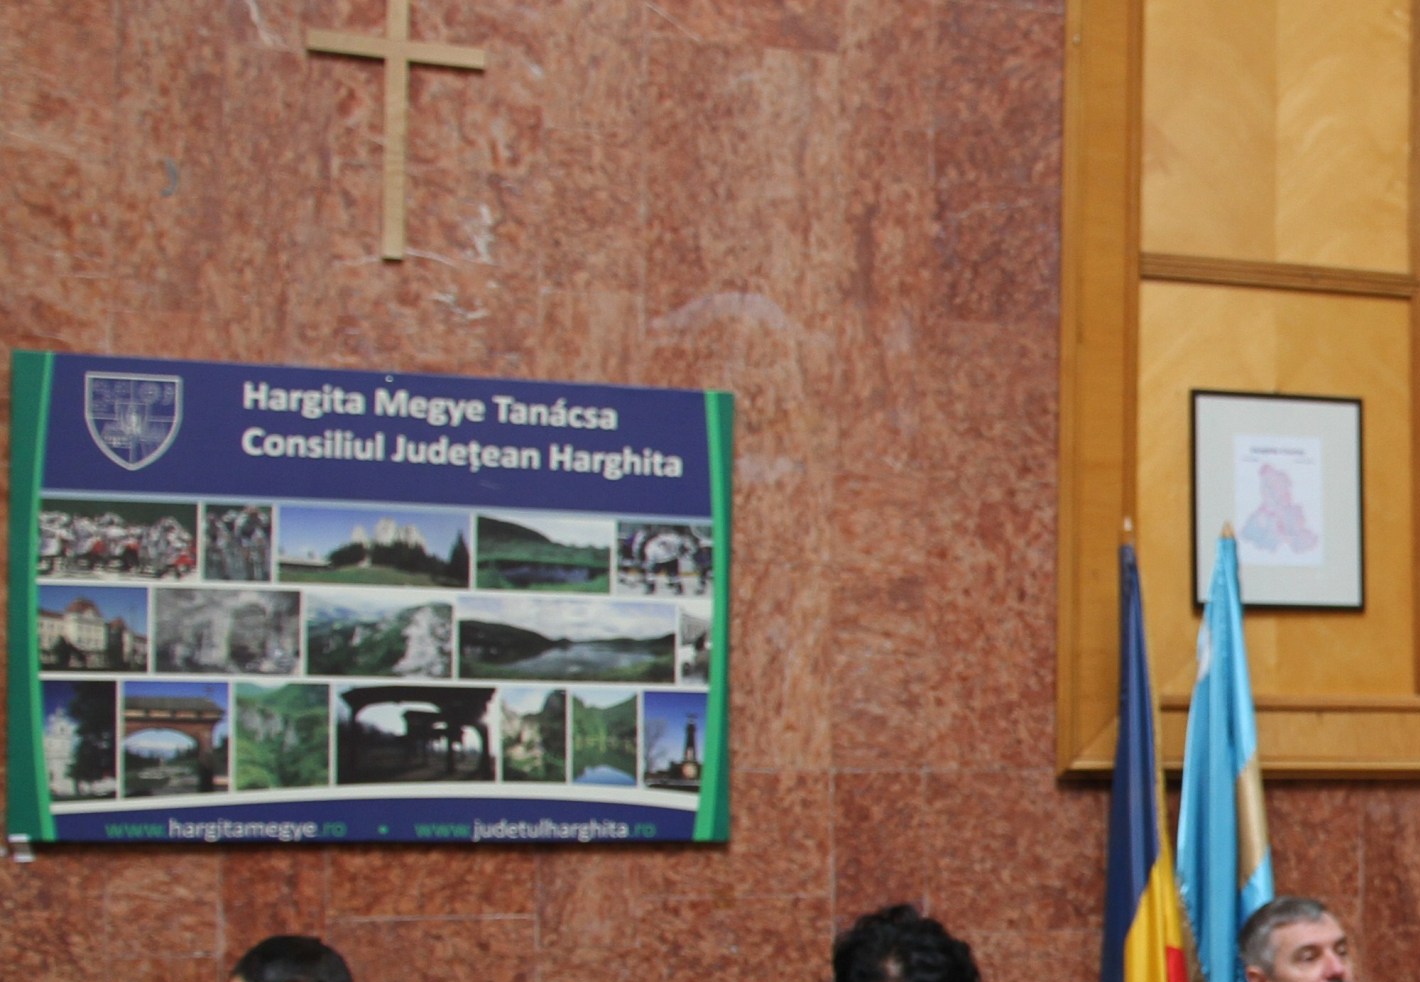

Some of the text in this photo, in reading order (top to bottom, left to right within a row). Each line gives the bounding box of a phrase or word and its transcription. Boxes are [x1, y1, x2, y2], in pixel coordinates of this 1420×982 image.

[243, 381, 619, 430] Hargita Megye Tanácsa
[241, 427, 385, 462] Consiliul
[549, 443, 684, 480] Harghita
[104, 817, 657, 843] www.hargitamegye.ro www.judetulharghita.ro
